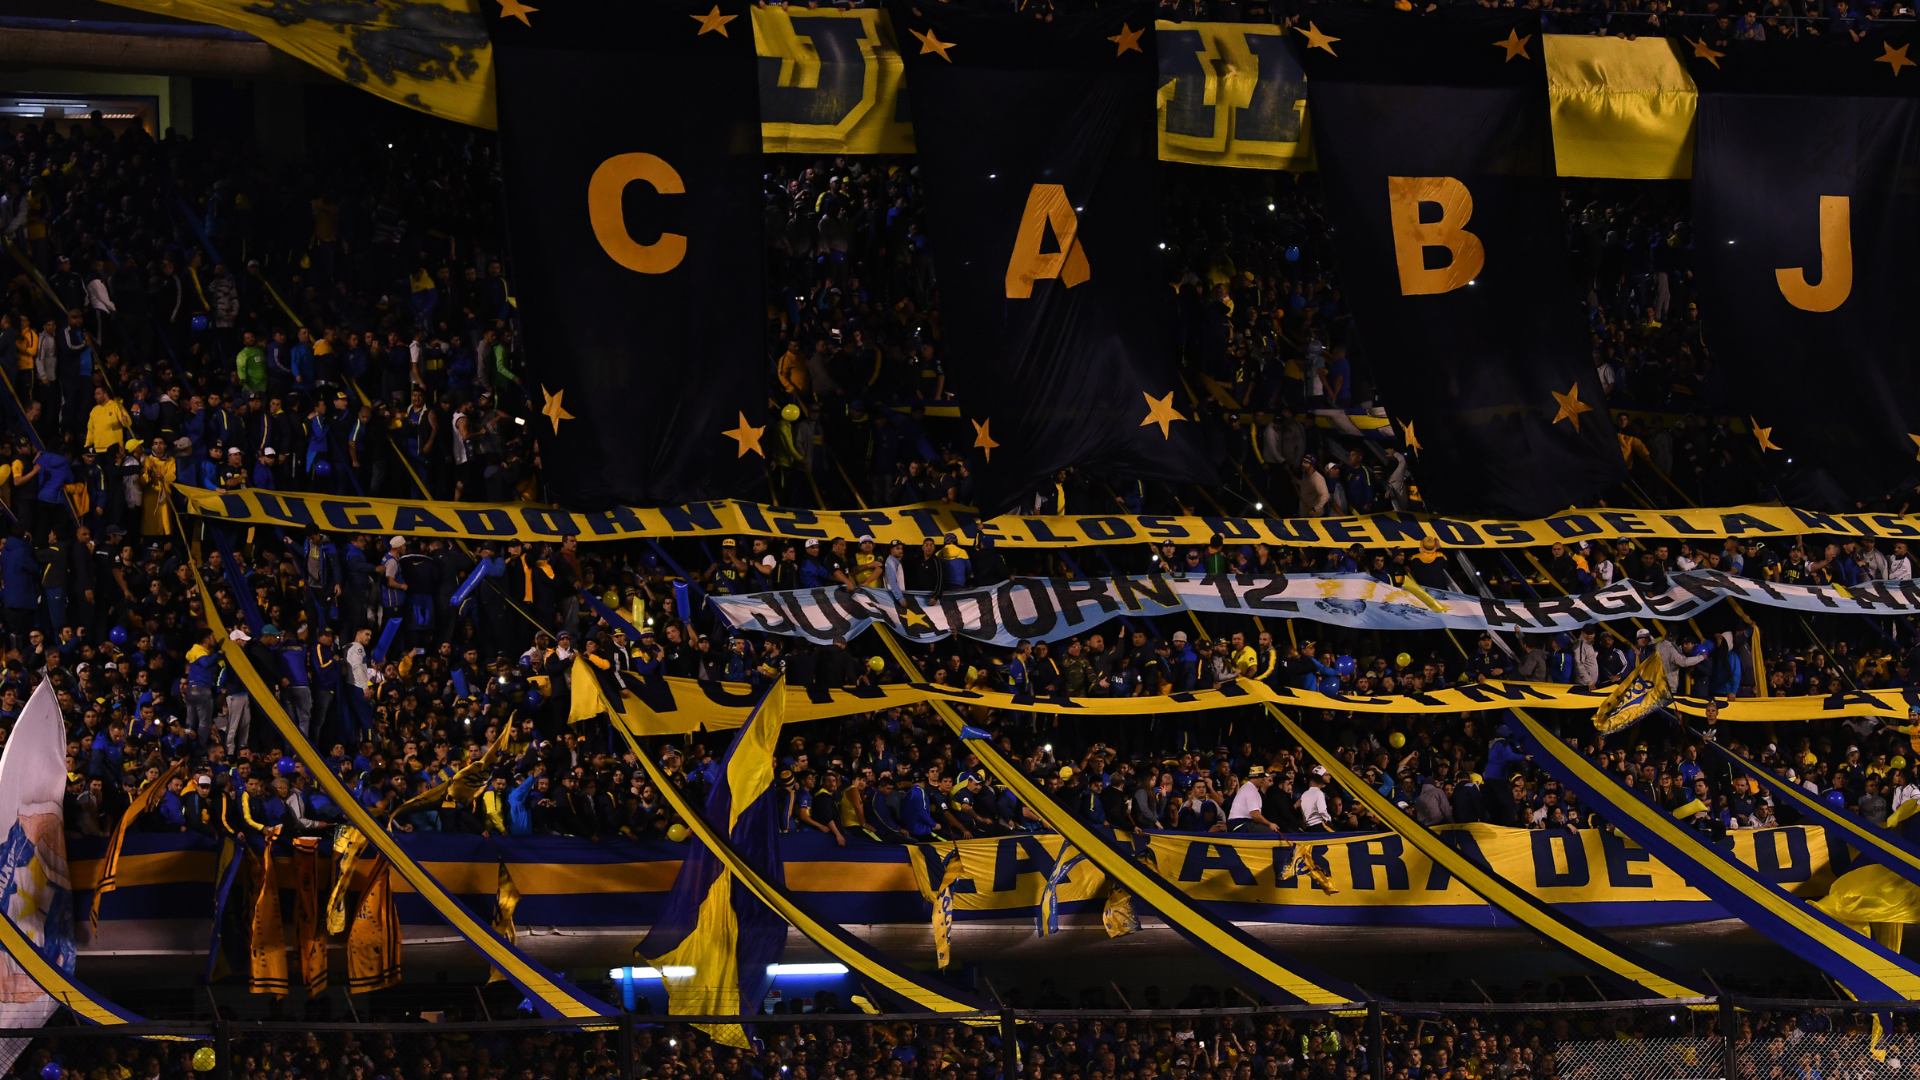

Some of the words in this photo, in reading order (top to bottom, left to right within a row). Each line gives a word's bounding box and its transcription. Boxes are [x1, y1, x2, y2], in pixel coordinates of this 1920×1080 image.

[200, 491, 646, 535] JUGADOR
[1023, 516, 1190, 542] LOS
[1545, 512, 1656, 538] DE
[1660, 512, 1784, 534] LA
[750, 578, 1121, 641] JUGADOR
[1200, 573, 1300, 611] 12
